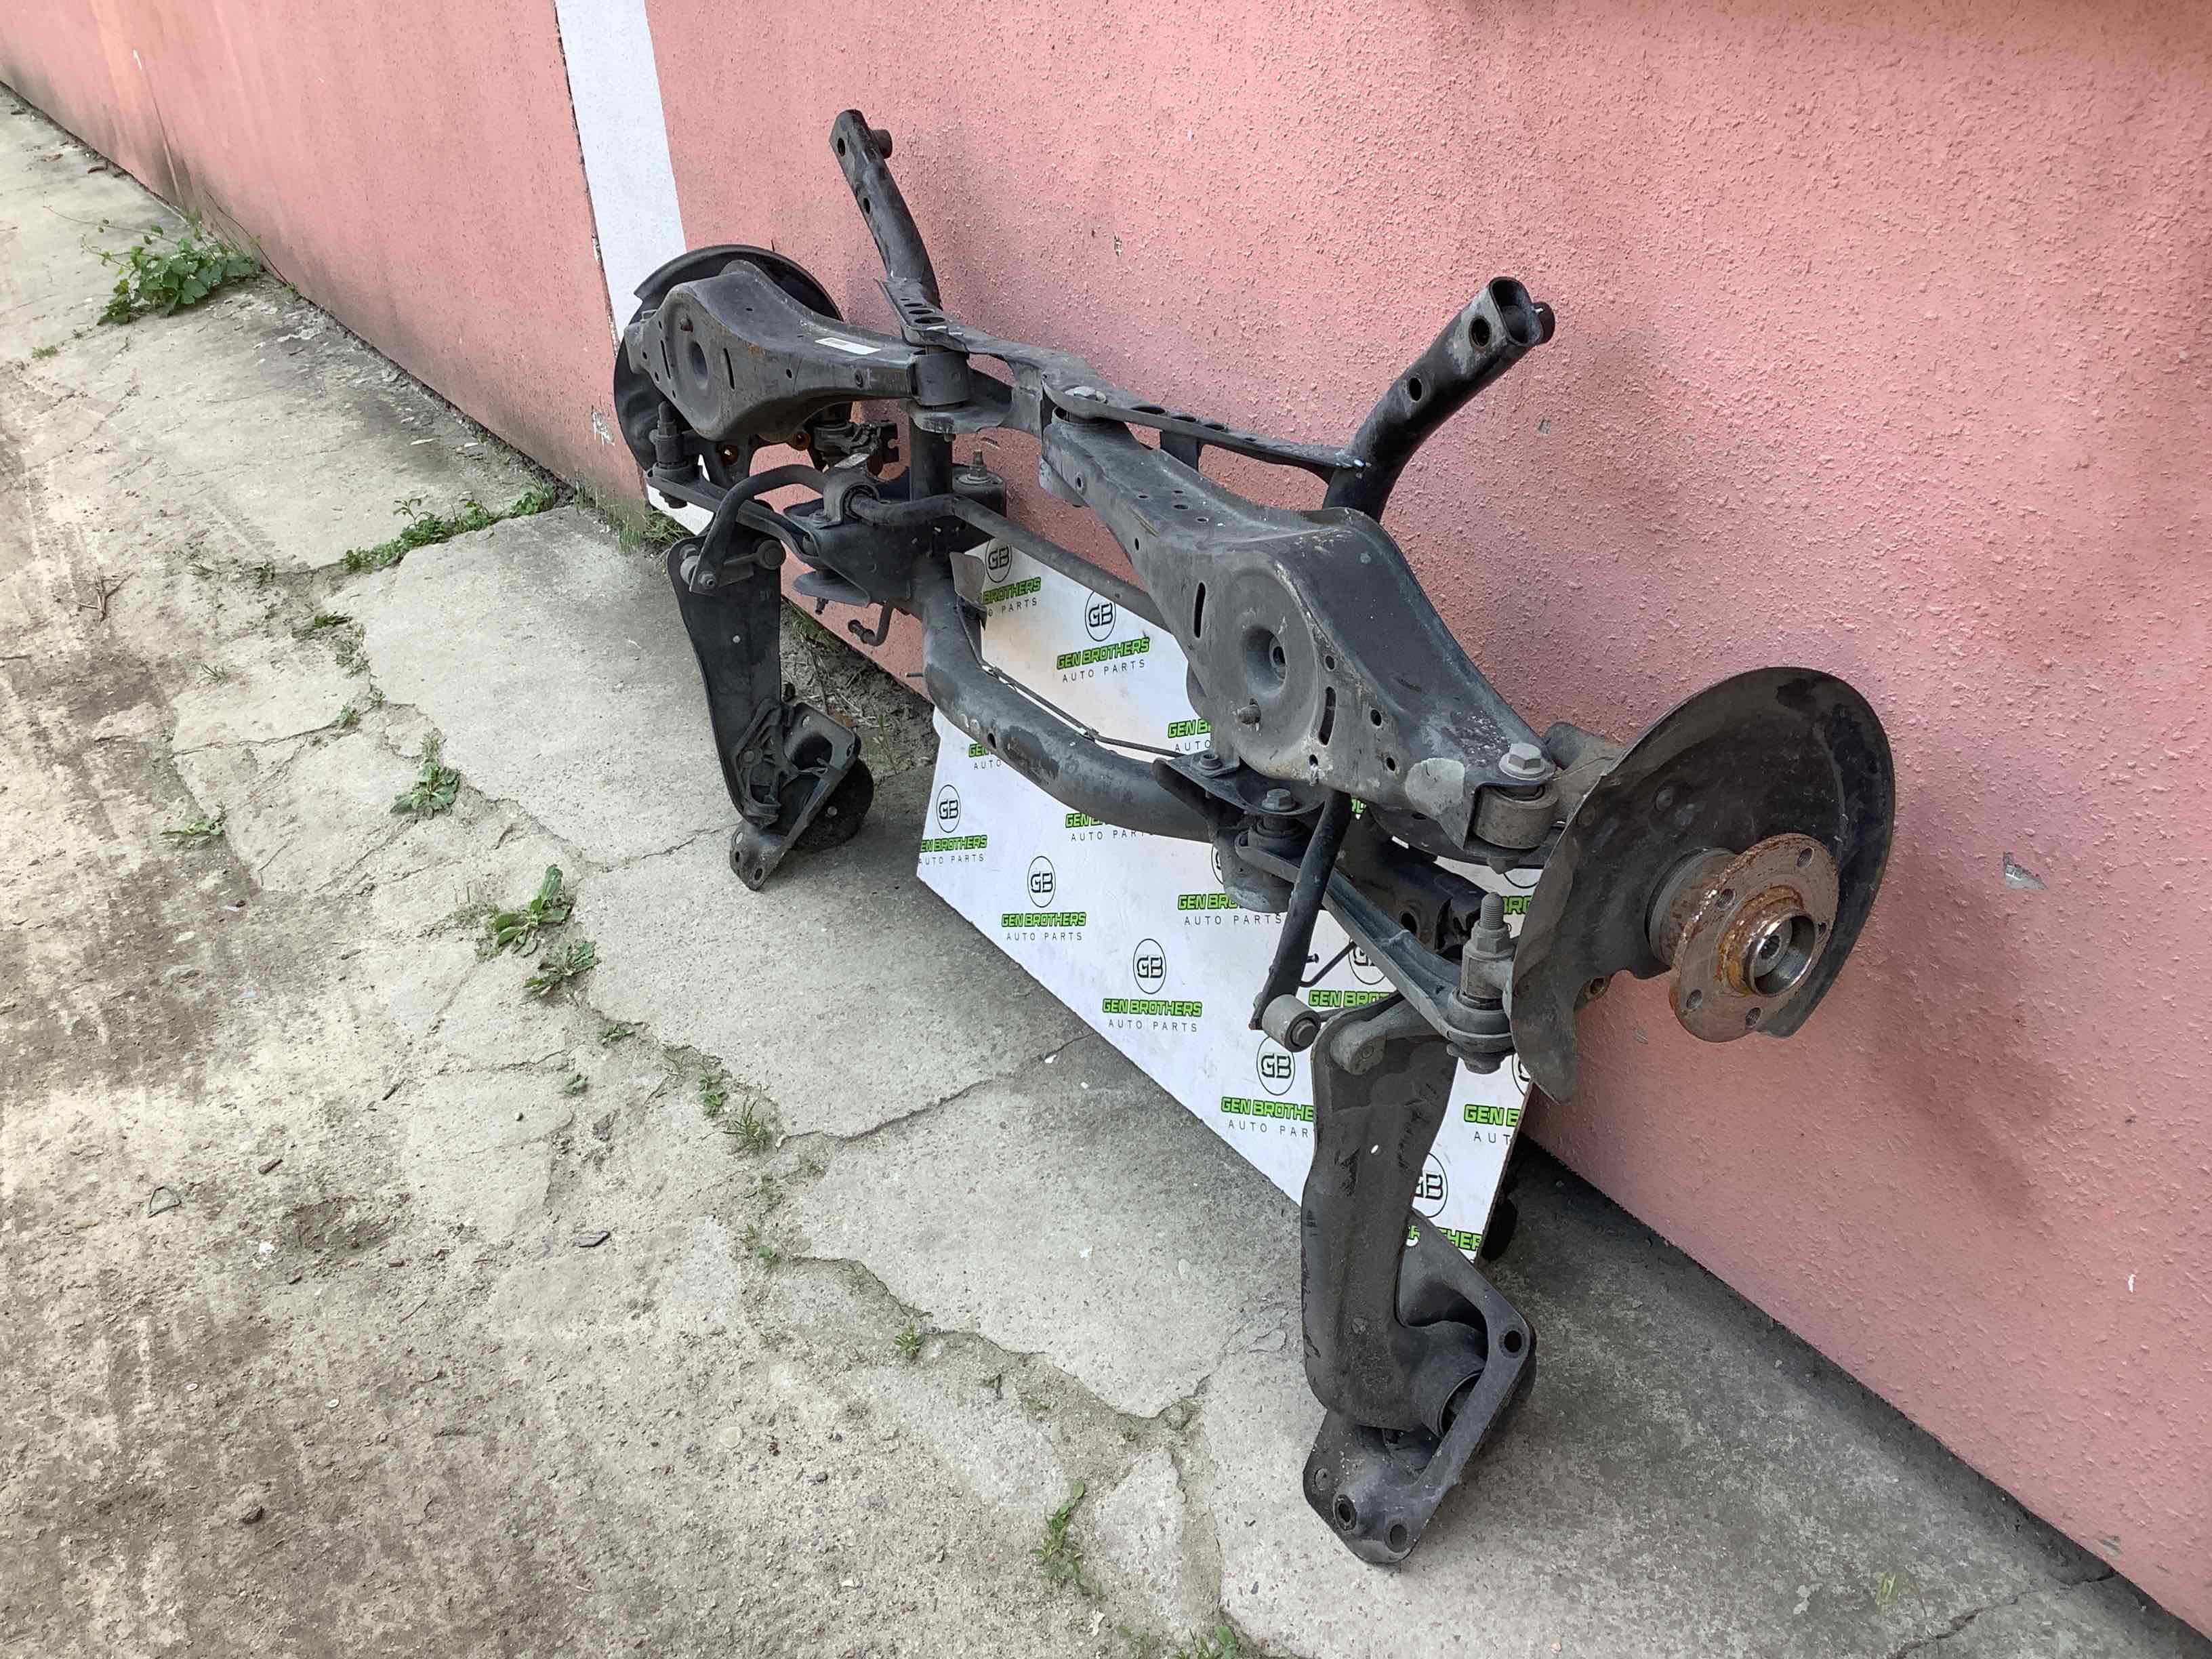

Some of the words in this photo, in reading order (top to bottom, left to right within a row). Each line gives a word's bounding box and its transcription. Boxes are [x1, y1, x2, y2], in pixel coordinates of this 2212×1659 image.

[988, 546, 1010, 570] GB
[982, 576, 1042, 605] BROTHERS
[1002, 597, 1038, 613] PARTS
[1088, 602, 1113, 628] GB
[1057, 651, 1082, 670] GEN
[1081, 636, 1150, 665] BROTHERS
[1062, 669, 1094, 684] AUTO
[1104, 659, 1145, 676] PARTS
[1168, 719, 1196, 739] GEN
[1174, 739, 1211, 752] AUTO
[974, 759, 1002, 771] AUTO
[939, 800, 959, 819] GB
[1065, 813, 1089, 828] GEN
[921, 840, 933, 853] EN
[933, 834, 988, 852] BROTHERS
[1071, 831, 1103, 842] AUTO
[951, 853, 985, 863] PARTS
[1031, 871, 1053, 893] GB
[1177, 894, 1207, 910] GEN
[1002, 914, 1023, 927] GEN
[1024, 912, 1087, 927] BROTHERS
[1184, 916, 1222, 926] AUTO
[1233, 914, 1282, 924] PARTS
[1006, 932, 1036, 941] AUTO
[1044, 932, 1082, 941] PARTS
[1136, 955, 1164, 978] GB
[1102, 998, 1129, 1014] GEN
[1129, 1000, 1203, 1017] BROTHERS
[1309, 989, 1343, 1008] GEN
[1108, 1019, 1143, 1029] AUTO
[1153, 1021, 1197, 1032] PARTS
[1261, 1053, 1292, 1079] GB
[1221, 1097, 1252, 1115] GEN
[1252, 1099, 1314, 1122] BROTHE
[1464, 1104, 1504, 1126] GEN
[1228, 1120, 1268, 1133] AUTO
[1279, 1125, 1313, 1139] PAR
[1473, 1130, 1511, 1145] AUT
